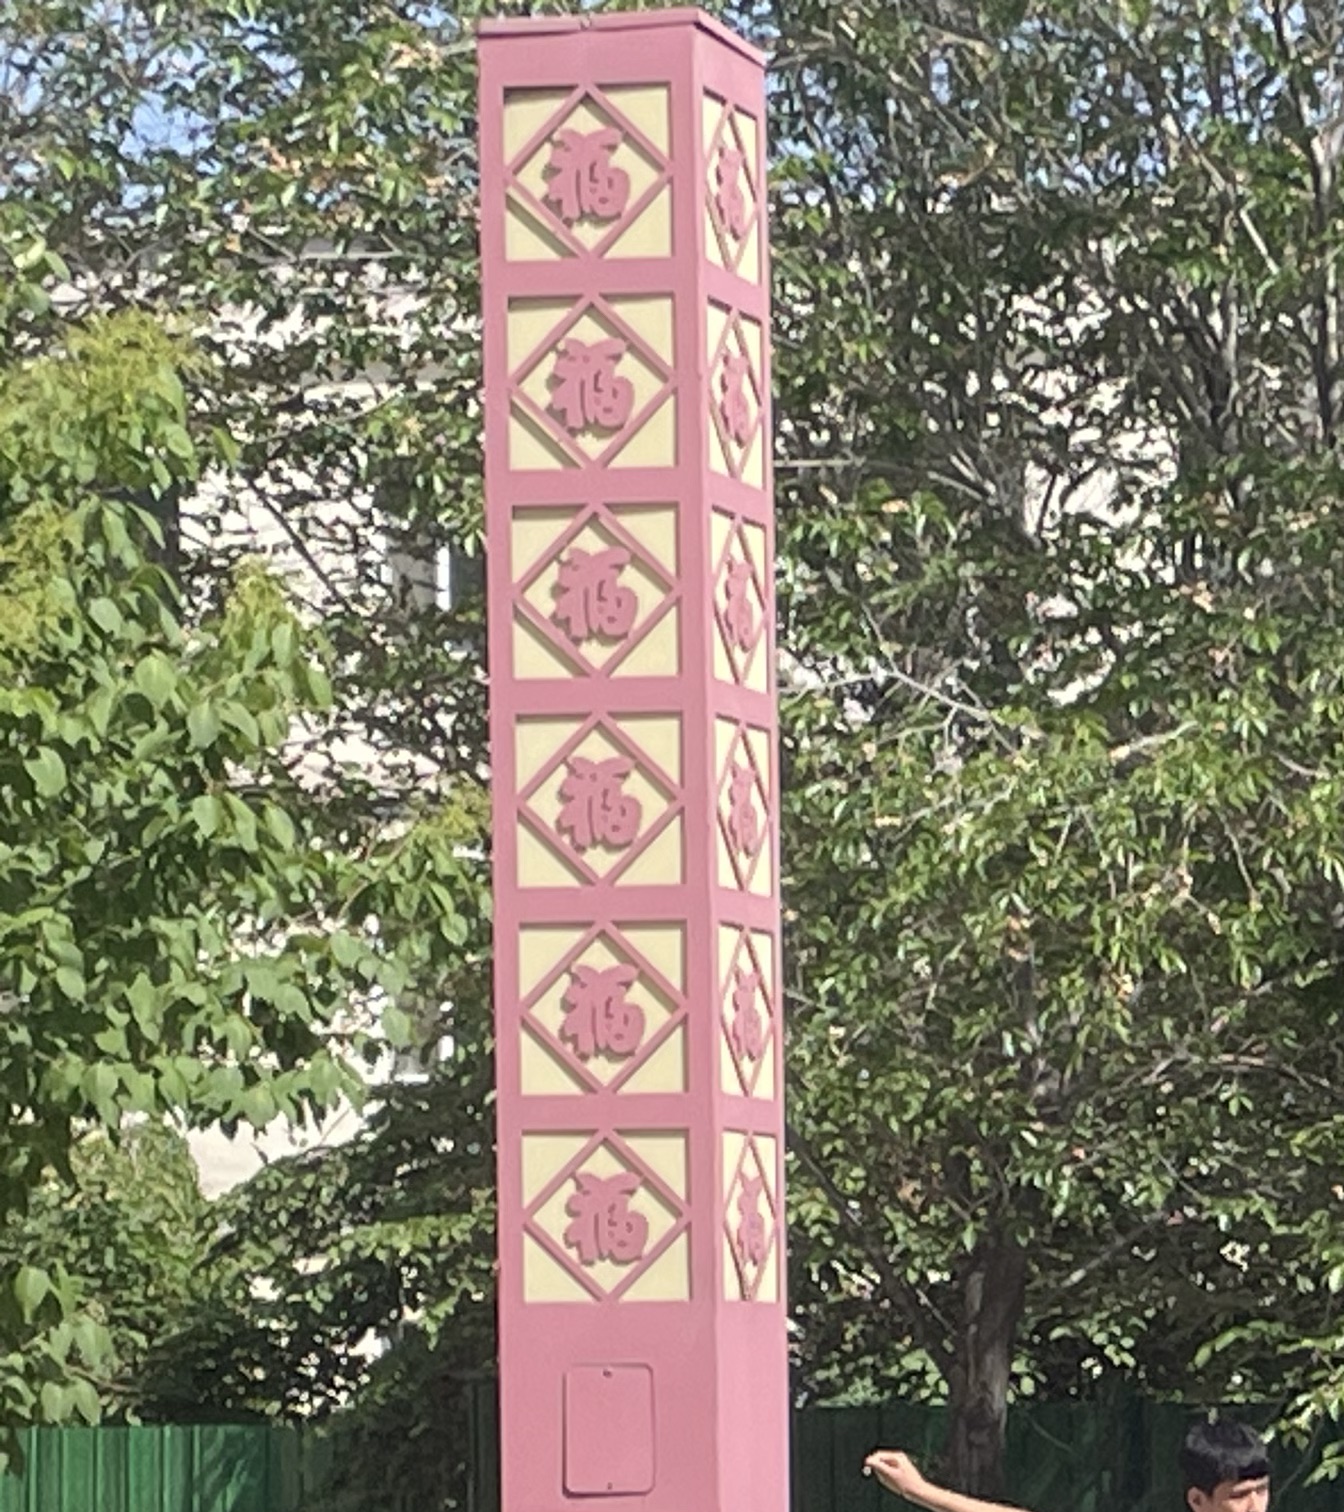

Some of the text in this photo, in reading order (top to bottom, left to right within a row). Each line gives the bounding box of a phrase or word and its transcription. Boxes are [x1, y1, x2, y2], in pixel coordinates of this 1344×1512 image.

[543, 127, 630, 220] 福
[548, 338, 635, 429] 福
[552, 547, 638, 639] 福
[556, 755, 642, 848] 福
[560, 962, 646, 1058] 福
[565, 1170, 649, 1263] 福
